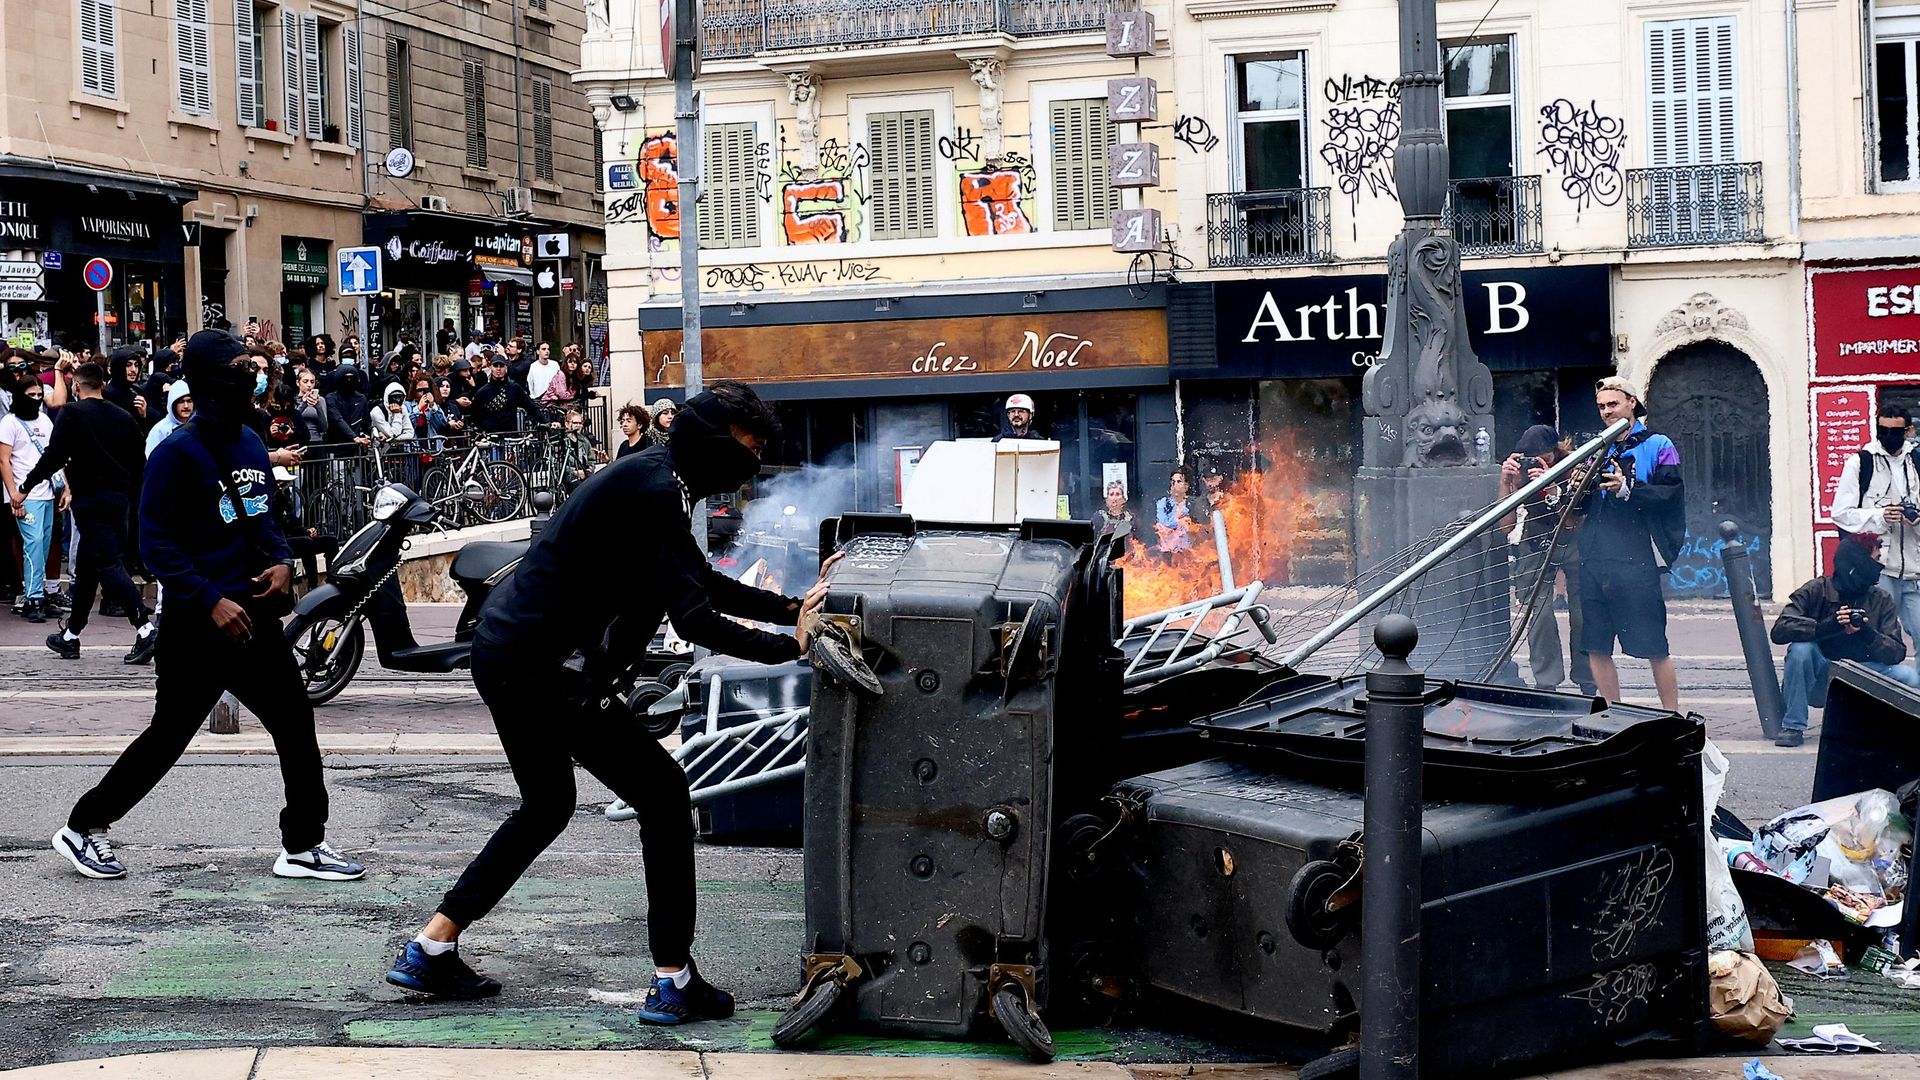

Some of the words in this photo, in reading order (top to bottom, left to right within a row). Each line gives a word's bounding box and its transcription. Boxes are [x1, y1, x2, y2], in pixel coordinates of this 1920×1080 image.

[81, 216, 151, 239] VAPORISSIMA
[181, 224, 196, 243] V
[1241, 287, 1388, 342] Arth
[1481, 281, 1530, 335] B
[911, 341, 978, 374] chez
[1839, 339, 1920, 357] IMPRIMER
